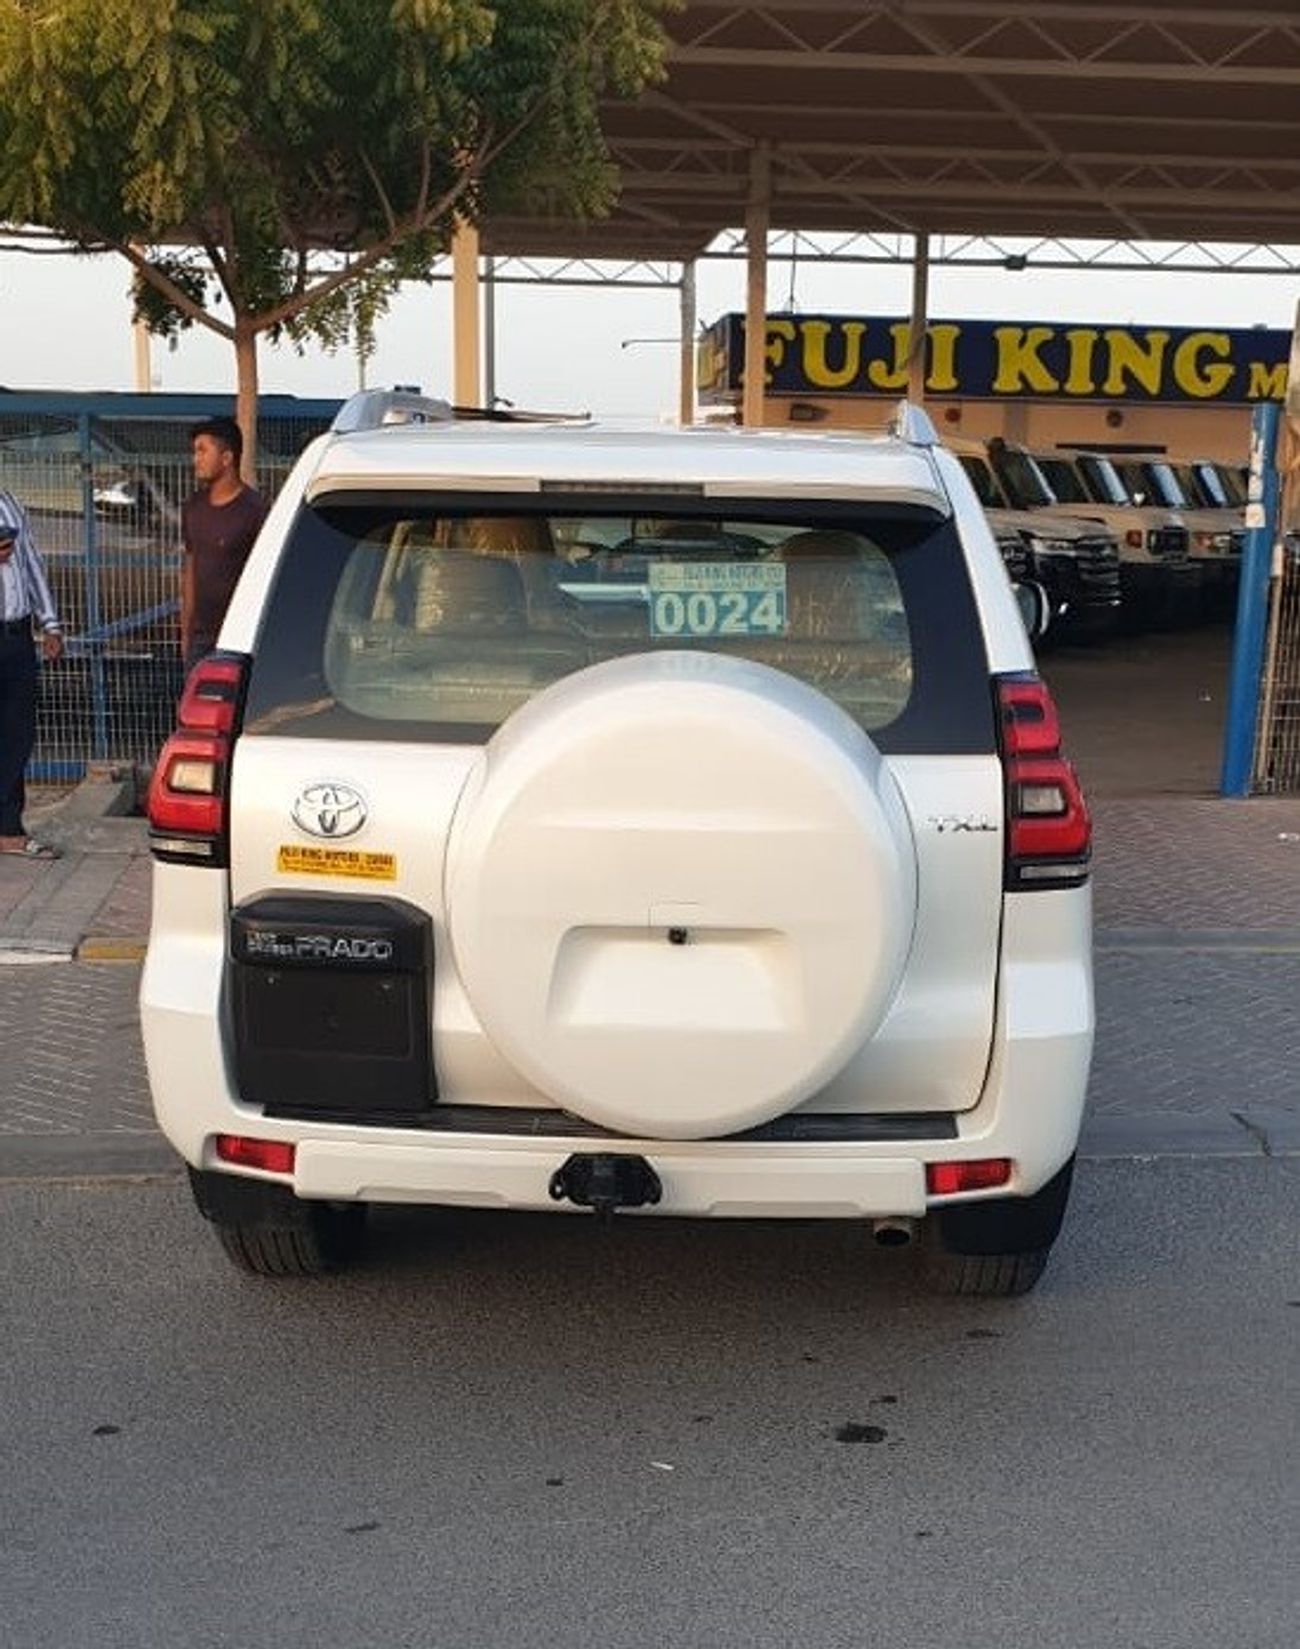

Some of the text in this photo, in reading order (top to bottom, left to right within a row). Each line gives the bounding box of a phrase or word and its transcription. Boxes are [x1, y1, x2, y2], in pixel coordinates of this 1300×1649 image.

[740, 320, 961, 390] FUJI
[992, 327, 1235, 397] KING
[655, 592, 782, 634] 0024
[296, 935, 393, 958] PRADO
